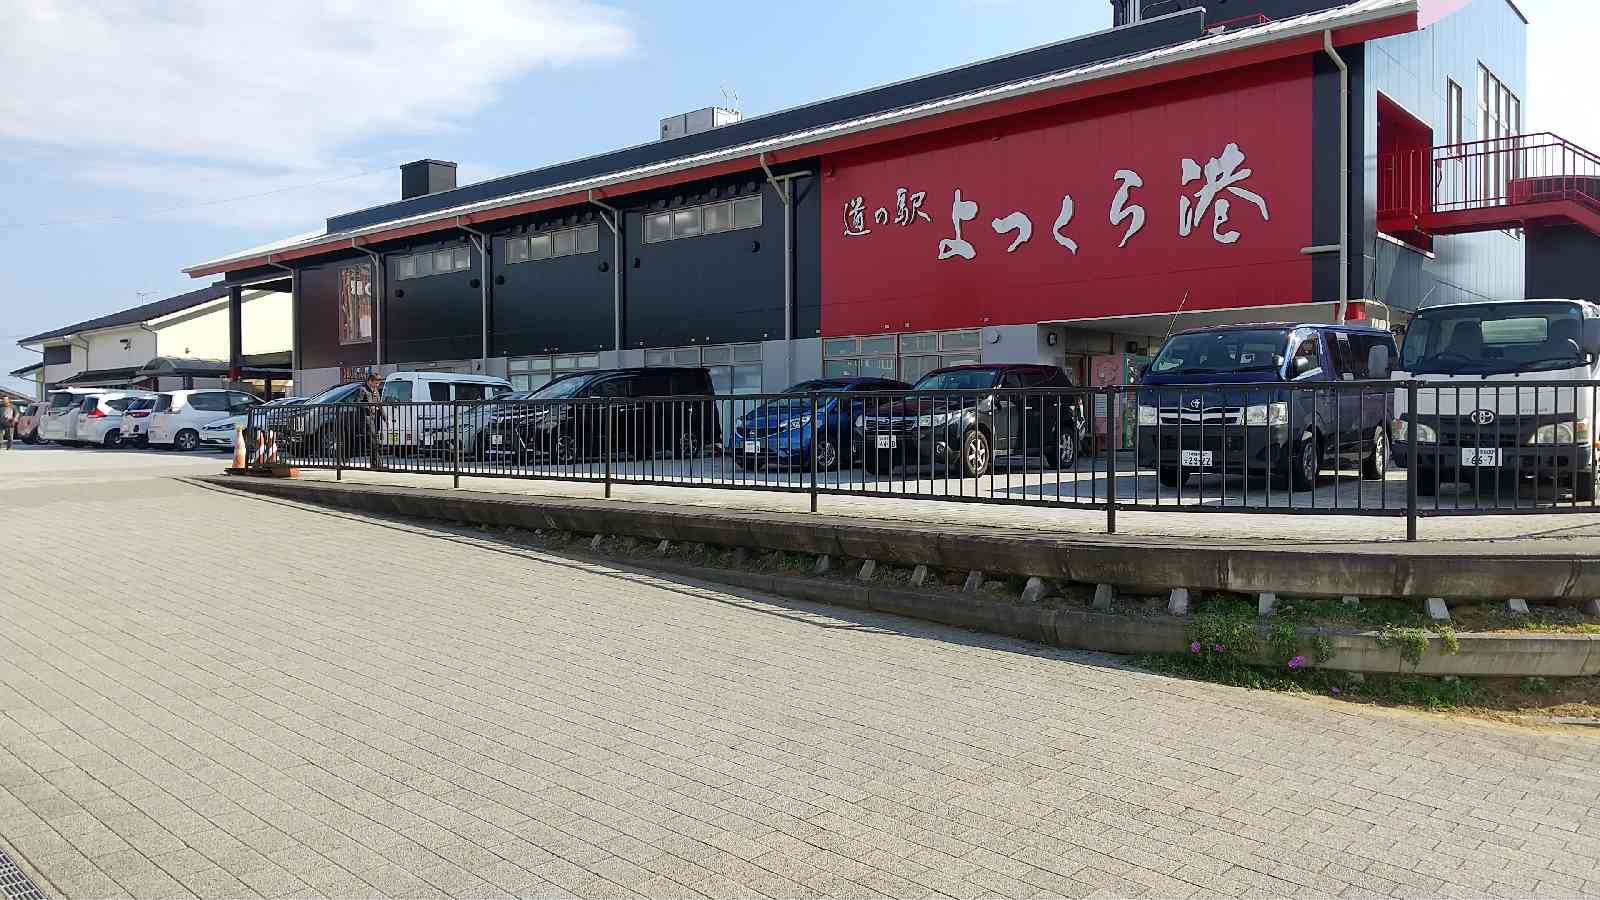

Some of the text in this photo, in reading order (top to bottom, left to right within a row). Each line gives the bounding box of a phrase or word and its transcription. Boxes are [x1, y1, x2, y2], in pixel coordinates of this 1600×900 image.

[843, 143, 1269, 260] 道の駅 よつくら港
